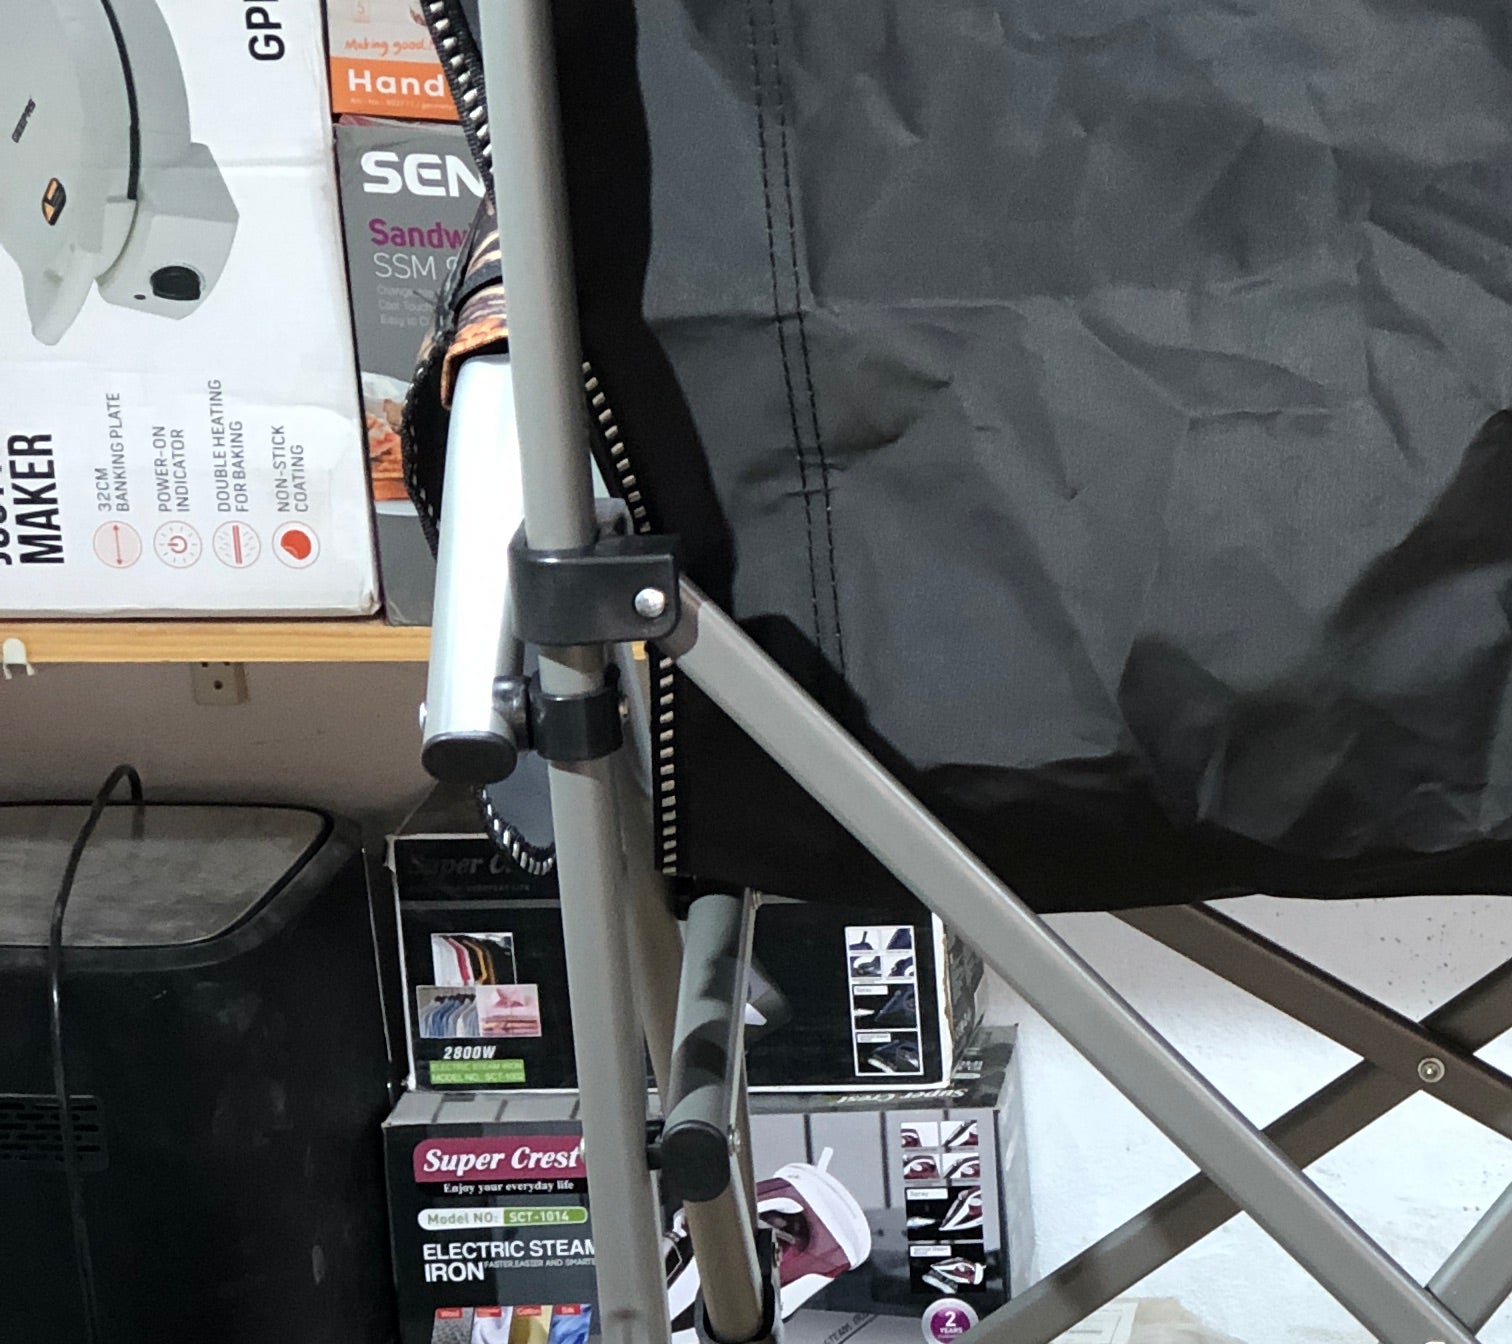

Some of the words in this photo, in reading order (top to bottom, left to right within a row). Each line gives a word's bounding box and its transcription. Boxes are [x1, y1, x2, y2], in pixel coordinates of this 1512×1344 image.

[345, 38, 389, 57] Making
[348, 68, 445, 97] Hand
[373, 252, 437, 280] SSM
[106, 393, 123, 439] PLATE
[207, 379, 225, 447] HEATING
[152, 426, 172, 512] POWER-ON
[229, 421, 246, 479] BAKING
[271, 425, 290, 512] NON-STICK
[110, 441, 130, 512] BANKING
[170, 428, 190, 512] INDICATOR
[213, 451, 231, 512] DOUBLE
[290, 444, 309, 512] COATING
[7, 434, 64, 564] MAKER
[94, 467, 112, 512] 32CM
[234, 483, 249, 512] FOR
[443, 1045, 497, 1060] 2800W
[424, 1148, 505, 1176] Super
[511, 1145, 580, 1169] Crest
[443, 1183, 475, 1194] Enjoy
[478, 1183, 503, 1194] your
[505, 1181, 554, 1193] everyday
[556, 1180, 574, 1190] life
[427, 1212, 470, 1225] Model
[509, 1211, 569, 1223] SCT-1014
[422, 1241, 524, 1261] ELECTRIC
[424, 1262, 485, 1283] IRON
[945, 1311, 956, 1327] 2
